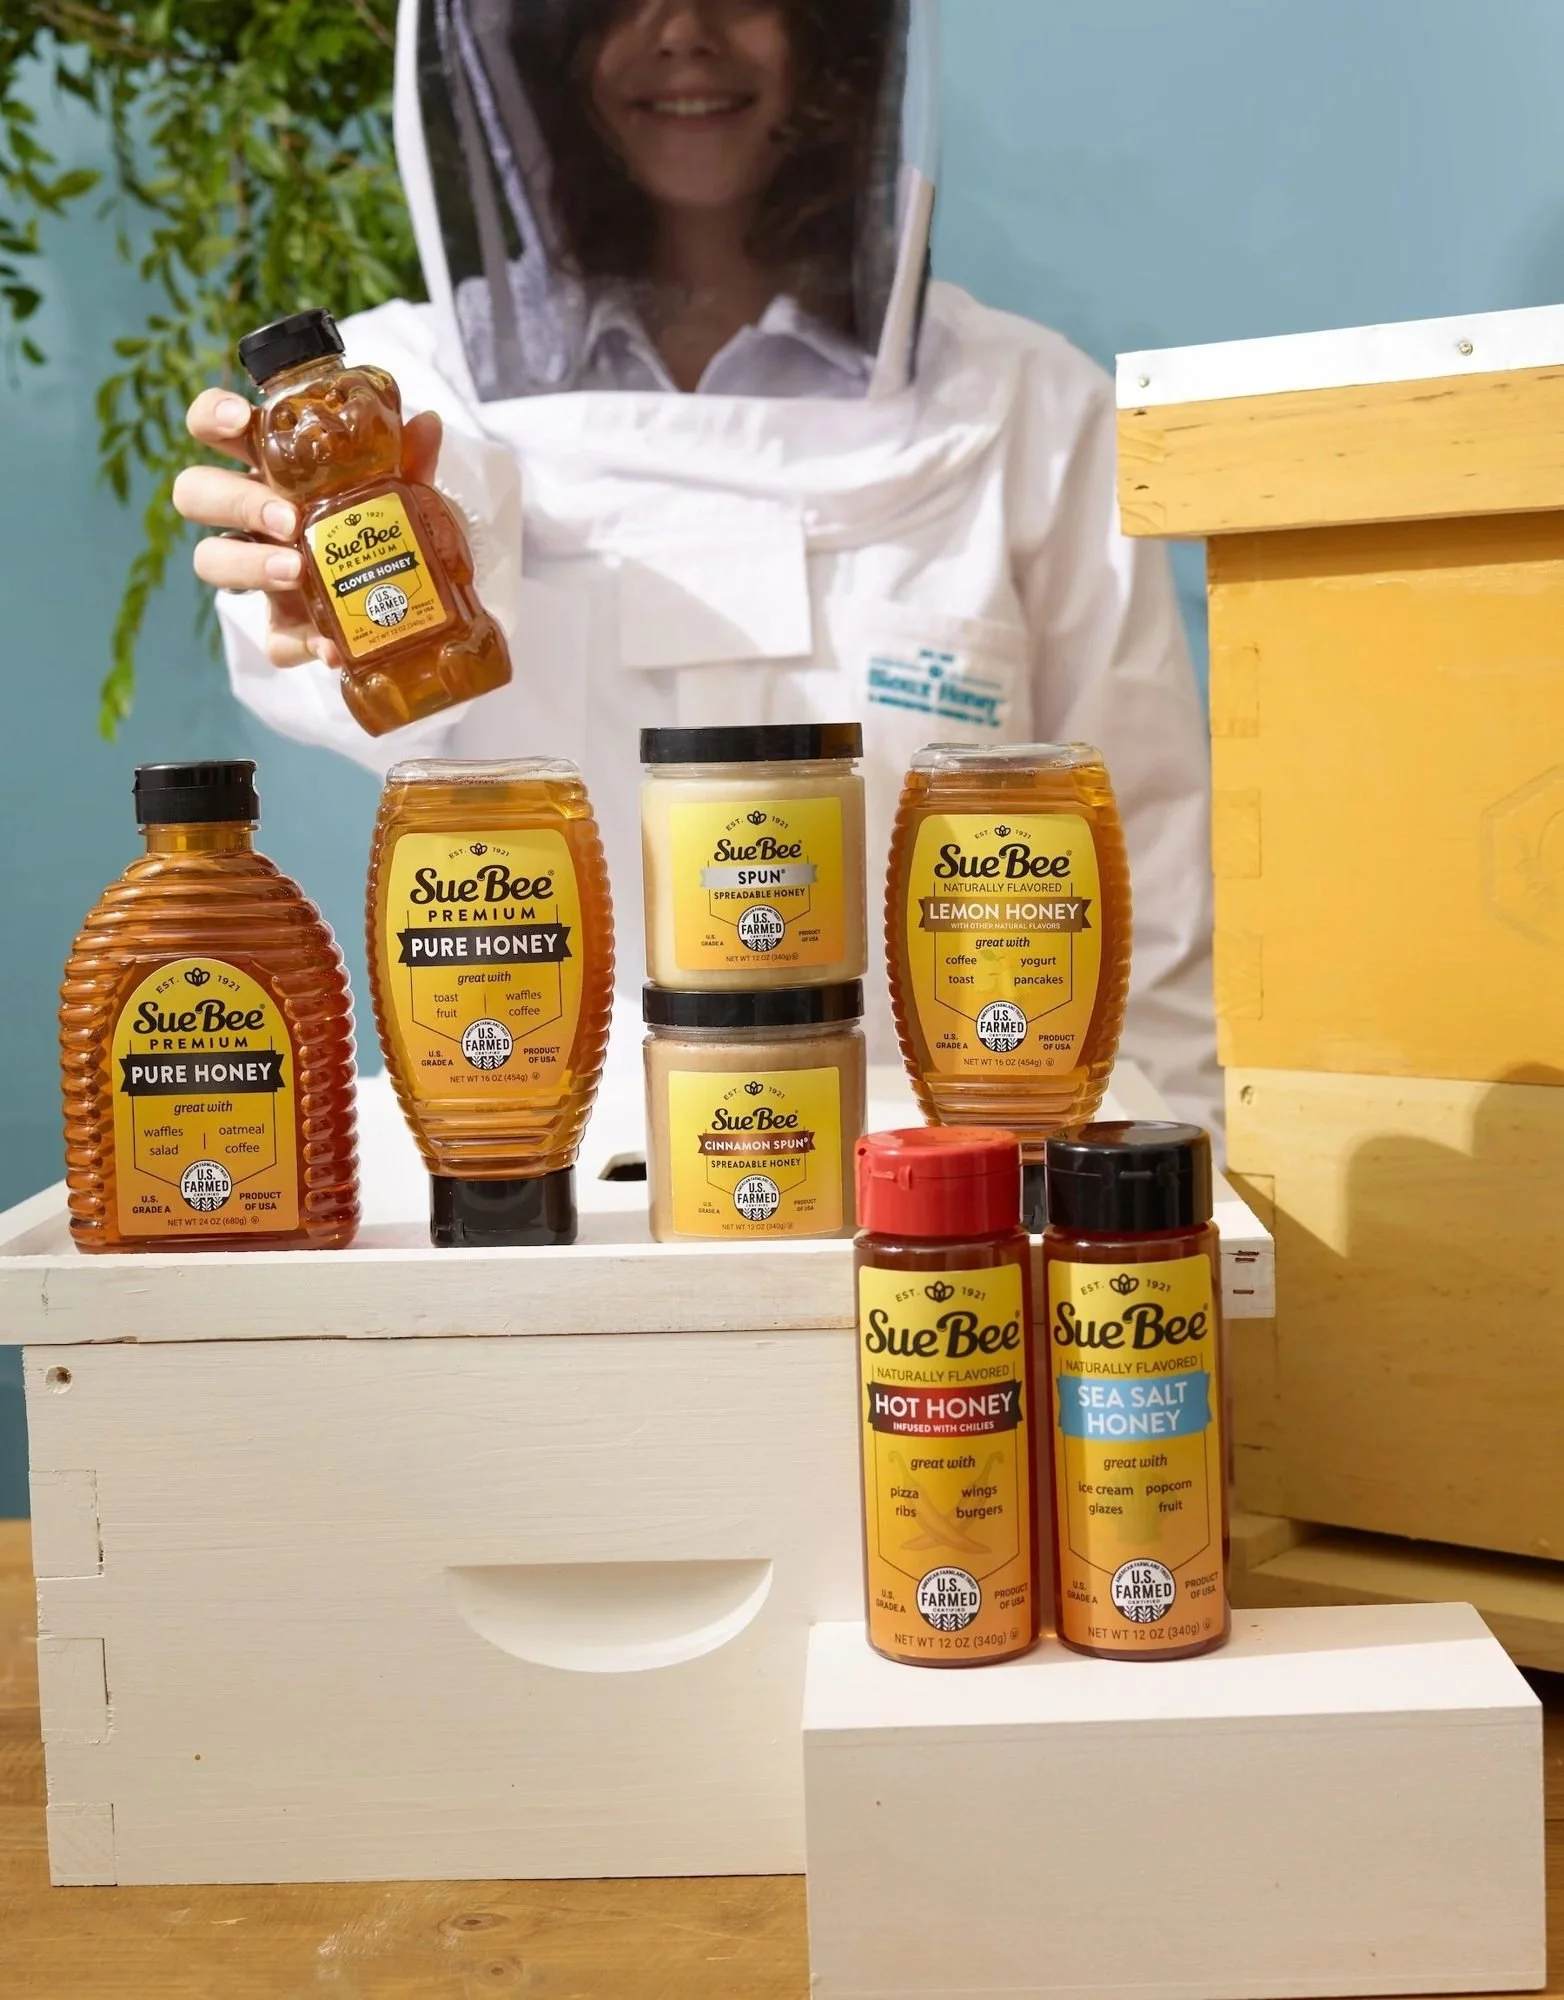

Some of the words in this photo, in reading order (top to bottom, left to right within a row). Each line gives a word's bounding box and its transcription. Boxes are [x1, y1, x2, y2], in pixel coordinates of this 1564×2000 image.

[339, 544, 397, 572] PREMIUM
[338, 572, 376, 593] CLOVER
[377, 557, 412, 577] HONEY
[375, 590, 392, 603] U.S.
[369, 595, 405, 616] FARMED
[772, 816, 789, 829] 1921
[1015, 829, 1032, 839] 1921
[449, 848, 467, 859] EST.
[492, 847, 510, 857] 1921
[943, 882, 1004, 893] NATURALLY
[1007, 883, 1062, 892] FLAVORED
[714, 890, 771, 900] SPREADABLE
[774, 889, 805, 898] HONEY
[428, 907, 536, 923] PREMIUM
[753, 913, 770, 924] U.S.
[929, 904, 999, 920] LEMON
[1006, 904, 1079, 920] HONEY
[741, 922, 782, 935] FARMED
[411, 937, 468, 958] PURE
[476, 934, 558, 956] HONEY
[975, 937, 1004, 950] great
[1005, 937, 1030, 948] with
[945, 955, 977, 965] coffee
[1020, 956, 1057, 968] yogurt
[156, 976, 180, 994] EST.
[217, 975, 241, 992] 1921
[458, 973, 486, 986] great
[487, 972, 512, 983] with
[948, 975, 975, 984] toast
[1014, 975, 1063, 987] pancakes
[434, 993, 459, 1003] toast
[506, 990, 542, 1001] waffles
[437, 1008, 458, 1019] fruit
[509, 1006, 541, 1017] coffee
[993, 1010, 1011, 1021] U.S.
[478, 1027, 497, 1040] U.S.
[980, 1021, 1024, 1033] FARMED
[150, 1037, 249, 1050] PREMIUM
[1038, 1034, 1075, 1042] PRODUCT
[466, 1039, 510, 1052] FARMED
[523, 1047, 560, 1055] PRODUCT
[936, 1042, 961, 1050] GRADE
[421, 1059, 447, 1067] GRADE
[964, 1058, 980, 1066] NET
[980, 1058, 993, 1066] WT
[1005, 1058, 1016, 1066] OZ
[1018, 1058, 1042, 1068] (454g)
[131, 1065, 187, 1085] PURE
[195, 1062, 272, 1083] HONEY
[466, 1075, 480, 1083] WT
[481, 1075, 490, 1083] 16
[491, 1074, 503, 1082] OZ
[504, 1073, 528, 1083] (454g)
[768, 1086, 785, 1100] 1921
[174, 1102, 205, 1116] great
[207, 1102, 233, 1113] with
[144, 1126, 184, 1138] waffles
[219, 1124, 265, 1136] oatmeal
[150, 1144, 179, 1156] salad
[225, 1142, 260, 1154] coffee
[705, 1141, 771, 1151] CINNAMON
[711, 1160, 767, 1169] SPREADABLE
[770, 1159, 801, 1167] HONEY
[197, 1169, 216, 1182] U.S.
[184, 1179, 229, 1193] FARMED
[749, 1183, 766, 1193] U.S.
[239, 1192, 282, 1201] PRODUCT
[737, 1192, 777, 1204] FARMED
[132, 1206, 163, 1215] GRADE
[164, 1206, 171, 1214] A
[245, 1202, 256, 1211] OF
[258, 1202, 277, 1211] USA
[168, 1218, 185, 1227] NET
[184, 1218, 199, 1226] WT
[200, 1218, 211, 1226] 24
[210, 1218, 221, 1226] OZ
[222, 1216, 247, 1227] (680g)
[895, 1288, 920, 1302] EST.
[962, 1286, 986, 1302] 1921
[1080, 1282, 1104, 1296] EST.
[1147, 1280, 1172, 1293] 1921
[1066, 1360, 1133, 1375] NATURALLY
[1136, 1355, 1198, 1373] FLAVORED
[877, 1367, 945, 1383] NATURALLY
[948, 1365, 1009, 1382] FLAVORED
[1078, 1385, 1125, 1409] SEA
[1130, 1381, 1188, 1407] SALT
[875, 1391, 920, 1418] HOT
[927, 1391, 1013, 1419] HONEY
[893, 1422, 931, 1433] INFUSED
[933, 1423, 957, 1433] WITH
[959, 1421, 995, 1432] CHILIES
[1087, 1409, 1181, 1435] HONEY
[911, 1457, 944, 1471] great
[947, 1456, 976, 1468] with
[1104, 1457, 1137, 1471] great
[1140, 1454, 1167, 1468] with
[891, 1486, 919, 1499] pizza
[962, 1485, 998, 1499] wings
[1079, 1481, 1093, 1493] ice
[1096, 1486, 1134, 1496] cream
[1146, 1479, 1192, 1496] popcorn
[896, 1504, 917, 1517] ribs
[956, 1504, 1003, 1520] burgers
[1089, 1503, 1123, 1515] glazes
[1159, 1500, 1183, 1513] fruit
[1131, 1570, 1156, 1584] U.S.
[937, 1578, 961, 1592] U.S.
[1116, 1583, 1172, 1599] FARMED
[921, 1592, 977, 1607] FARMED
[1088, 1627, 1108, 1639] NET
[1110, 1628, 1129, 1640] WT
[1132, 1628, 1145, 1640] 12
[1149, 1626, 1165, 1639] OZ
[1168, 1622, 1200, 1640] (340g)
[894, 1633, 915, 1647] NET
[917, 1635, 937, 1648] WT
[939, 1636, 951, 1648] 12
[955, 1635, 970, 1648] OZ
[973, 1631, 1007, 1648] (340g)
